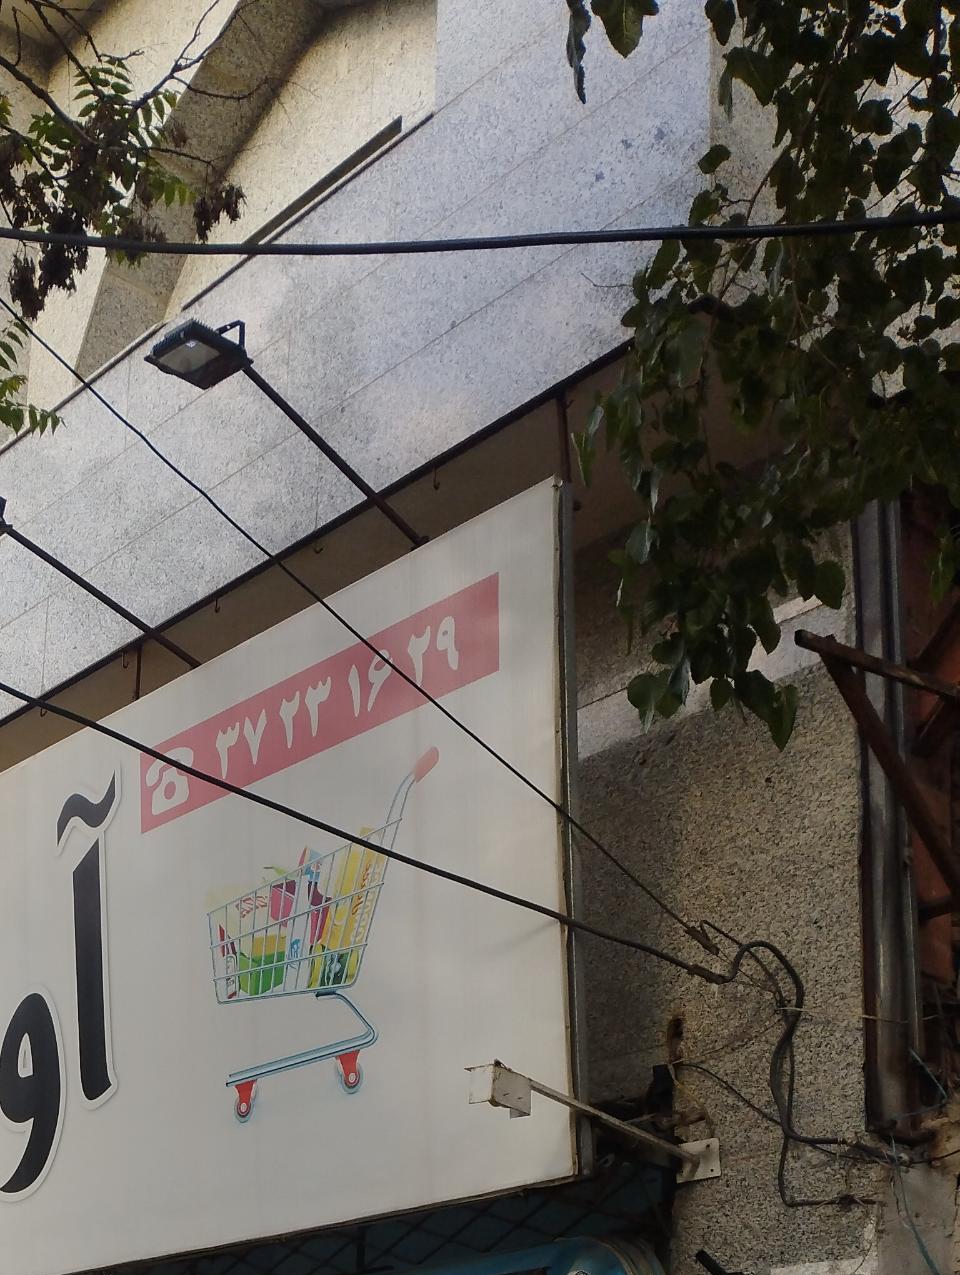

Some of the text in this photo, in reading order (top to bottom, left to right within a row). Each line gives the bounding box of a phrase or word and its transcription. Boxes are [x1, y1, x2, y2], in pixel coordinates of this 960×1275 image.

[216, 709, 267, 779] ۳۷
[280, 676, 331, 749] ۲۳
[407, 616, 459, 687] ۲۹
